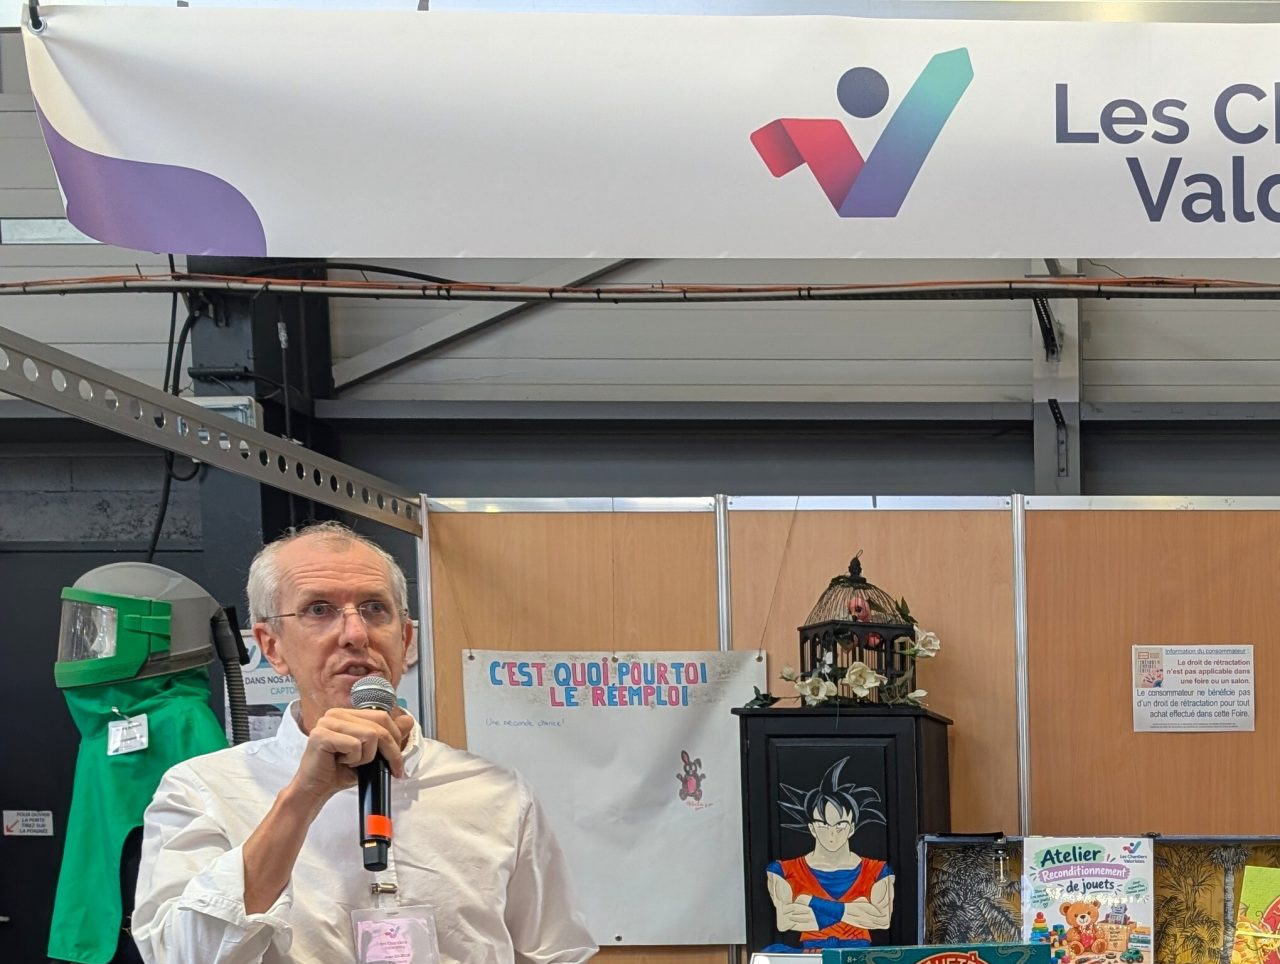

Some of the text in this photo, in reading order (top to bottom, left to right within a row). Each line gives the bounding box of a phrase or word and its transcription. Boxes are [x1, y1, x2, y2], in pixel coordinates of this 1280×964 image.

[1055, 83, 1190, 145] Les
[489, 660, 546, 687] C'EST
[617, 662, 669, 685] POUR
[671, 662, 708, 684] TOI
[1185, 669, 1197, 677] pas
[1198, 668, 1232, 677] applicable
[245, 676, 266, 685] DANS
[268, 675, 285, 684] NOS
[1194, 677, 1209, 685] foire
[550, 683, 689, 707] LE RÉEMPLOI
[1136, 688, 1145, 697] Le
[1147, 688, 1194, 697] consommateur
[1196, 689, 1206, 697] ne
[1238, 689, 1251, 698] pas
[1153, 699, 1168, 707] droit
[1170, 699, 1179, 707] de
[1181, 699, 1218, 707] rétractation
[1220, 700, 1237, 710] pour
[1237, 699, 1250, 707] tout
[1149, 710, 1168, 718] achat
[1196, 710, 1213, 718] dans
[1214, 710, 1230, 718] cette
[1041, 845, 1102, 868] Atelier
[1041, 865, 1127, 882] Reconditionnement
[1066, 880, 1080, 893] de
[1080, 878, 1115, 894] jouets
